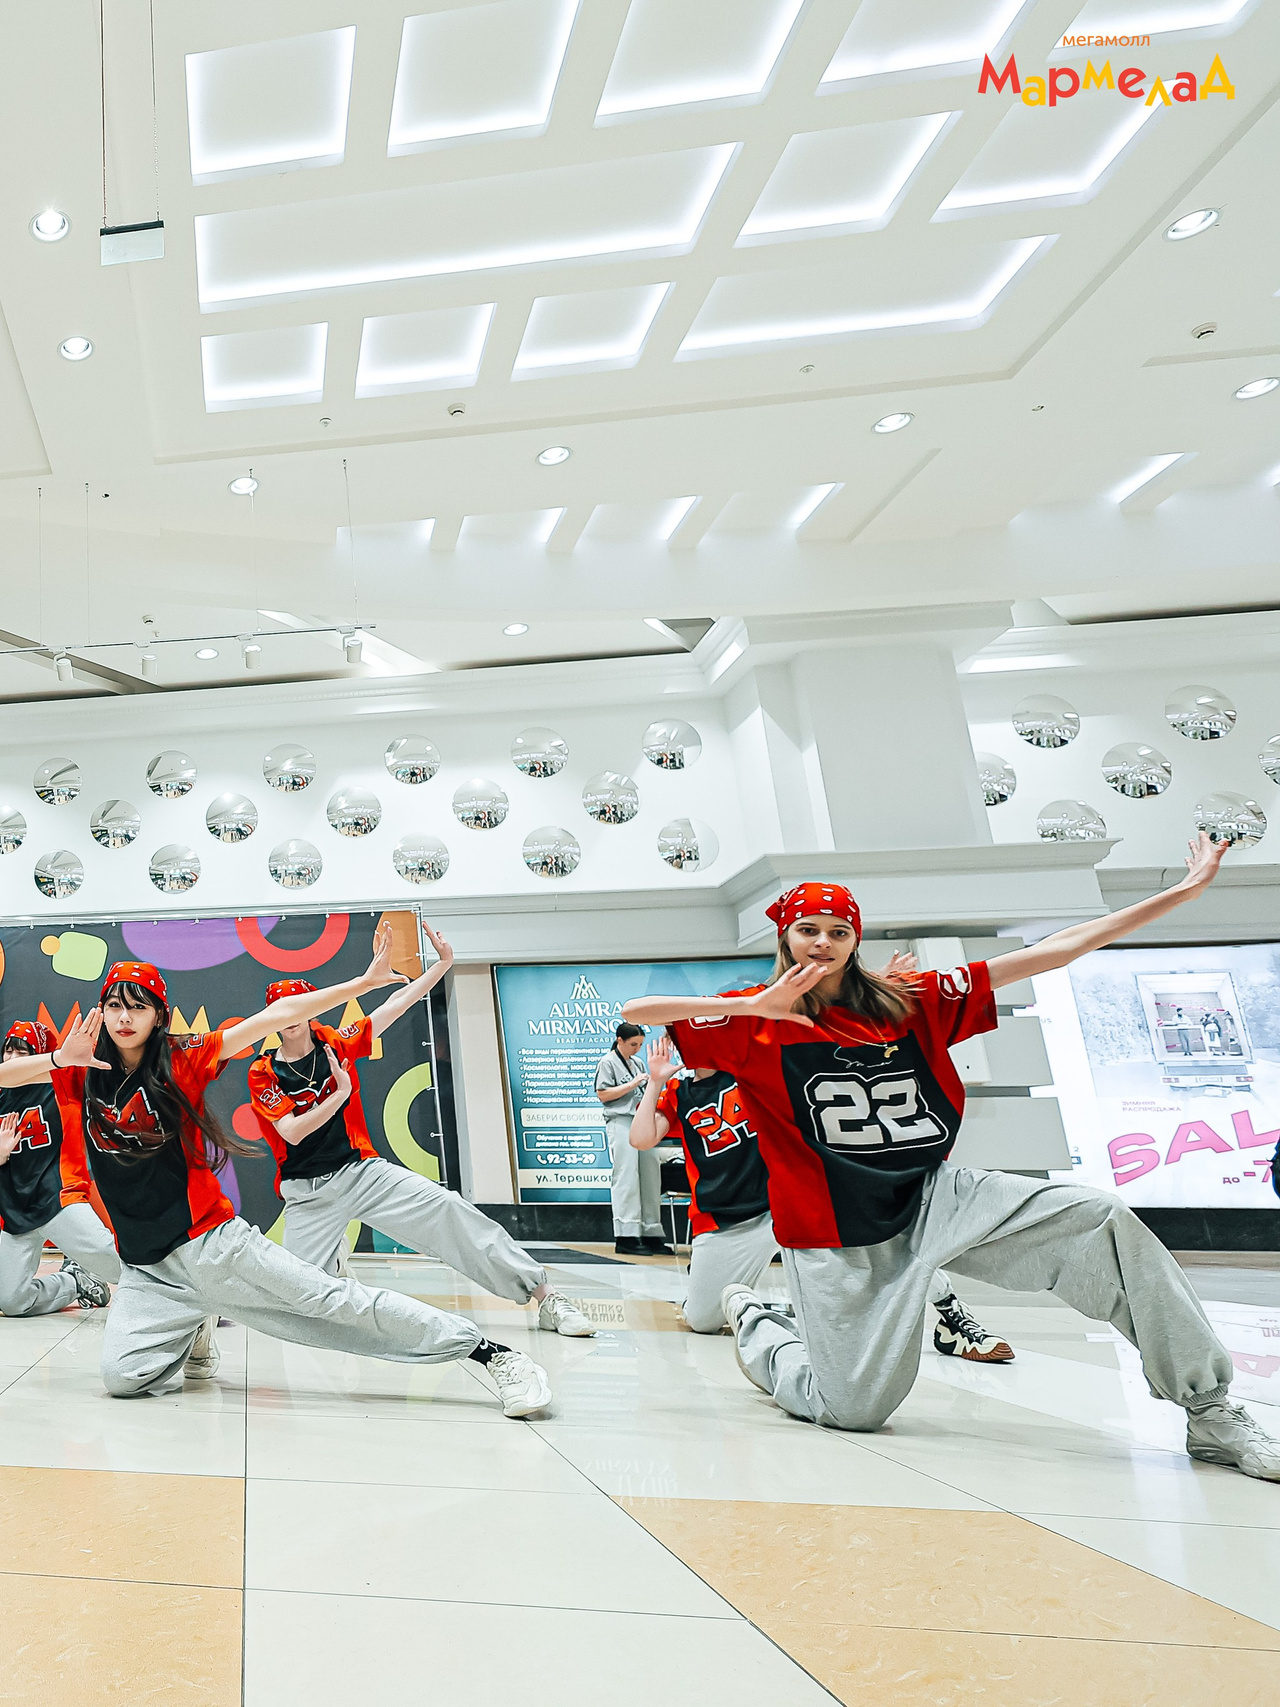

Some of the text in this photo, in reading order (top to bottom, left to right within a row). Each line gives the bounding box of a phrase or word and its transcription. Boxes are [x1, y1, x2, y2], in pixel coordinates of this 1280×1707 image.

[549, 1001, 624, 1018] ALMIRA
[526, 1114, 558, 1122] ЗАБЕРИ
[560, 1113, 585, 1122] СВОЙ
[805, 1070, 949, 1153] 22
[685, 1082, 757, 1157] 24
[547, 1154, 596, 1164] 92-33-29
[536, 1175, 552, 1184] ул.
